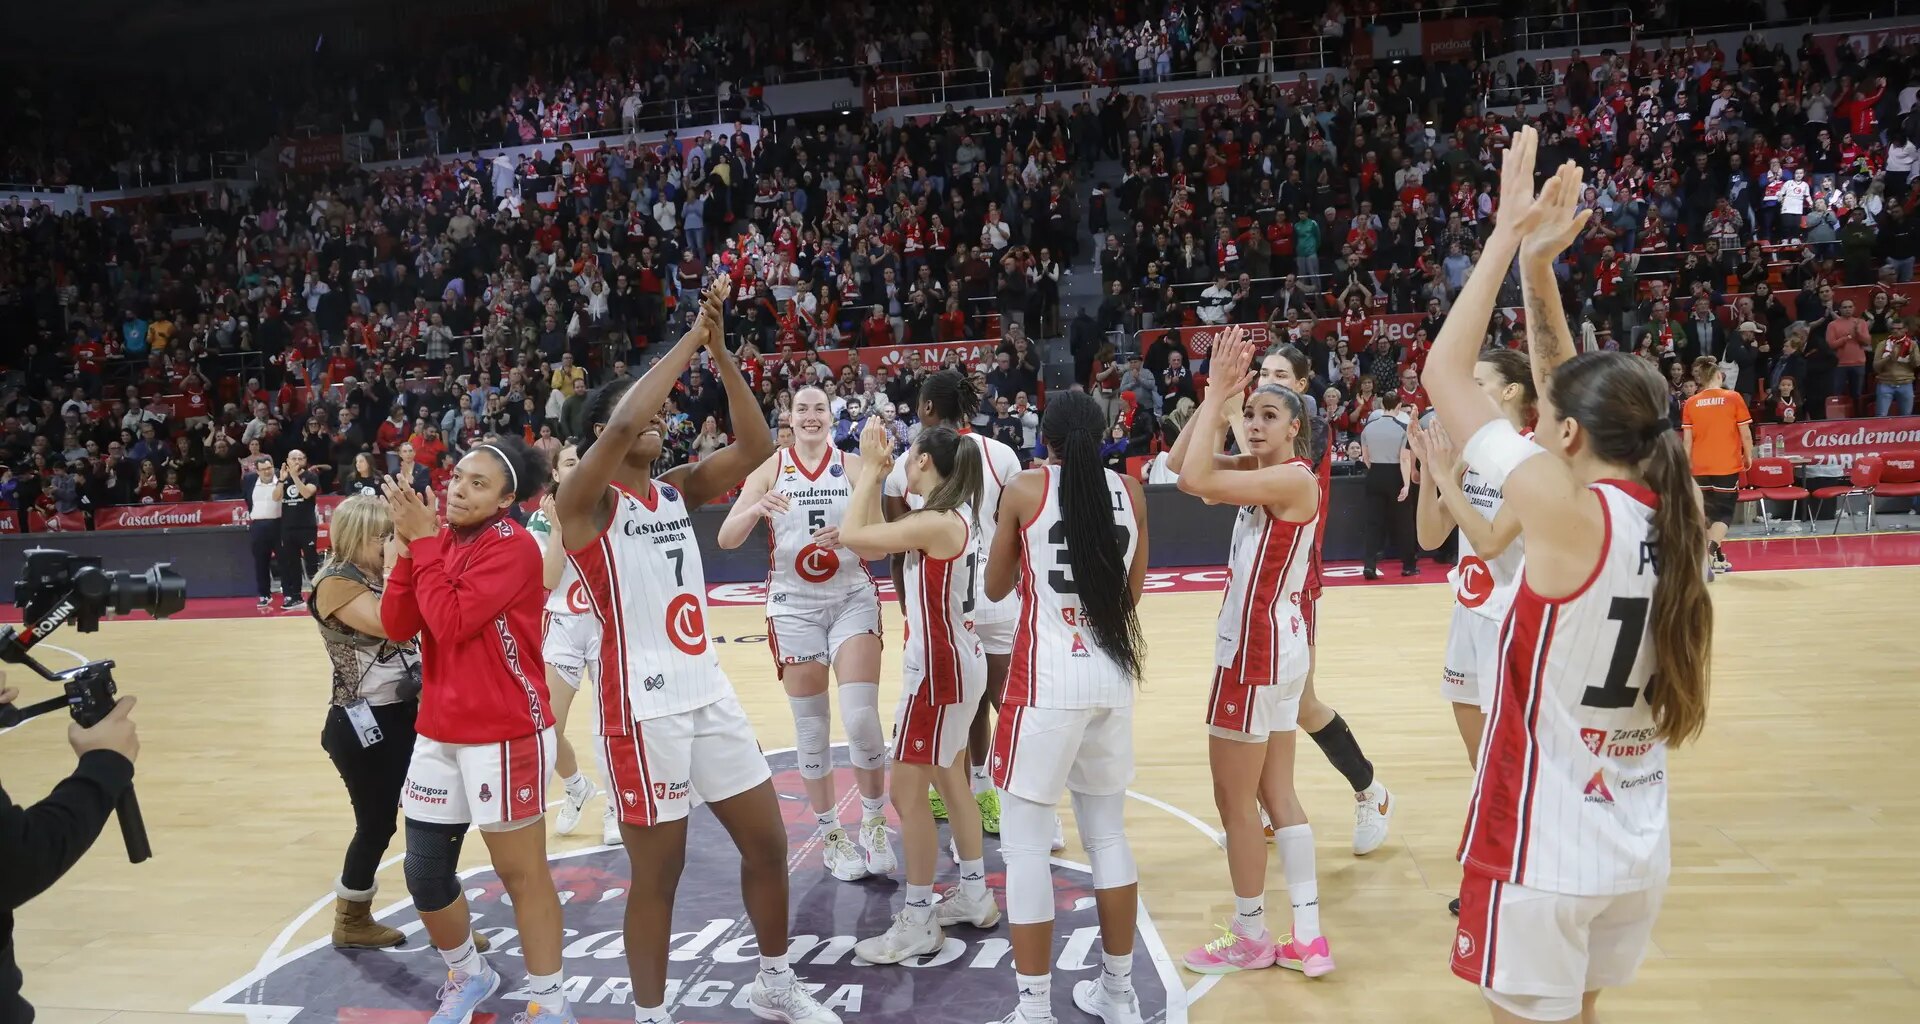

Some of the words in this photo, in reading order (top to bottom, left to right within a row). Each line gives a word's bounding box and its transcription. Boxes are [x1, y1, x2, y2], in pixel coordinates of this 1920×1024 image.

[798, 498, 833, 506] ZARAGOZA
[118, 510, 203, 527] Casademont
[808, 510, 826, 536] 5
[665, 547, 684, 588] 7
[31, 601, 75, 639] RONIN
[411, 781, 448, 796] Zaragoza
